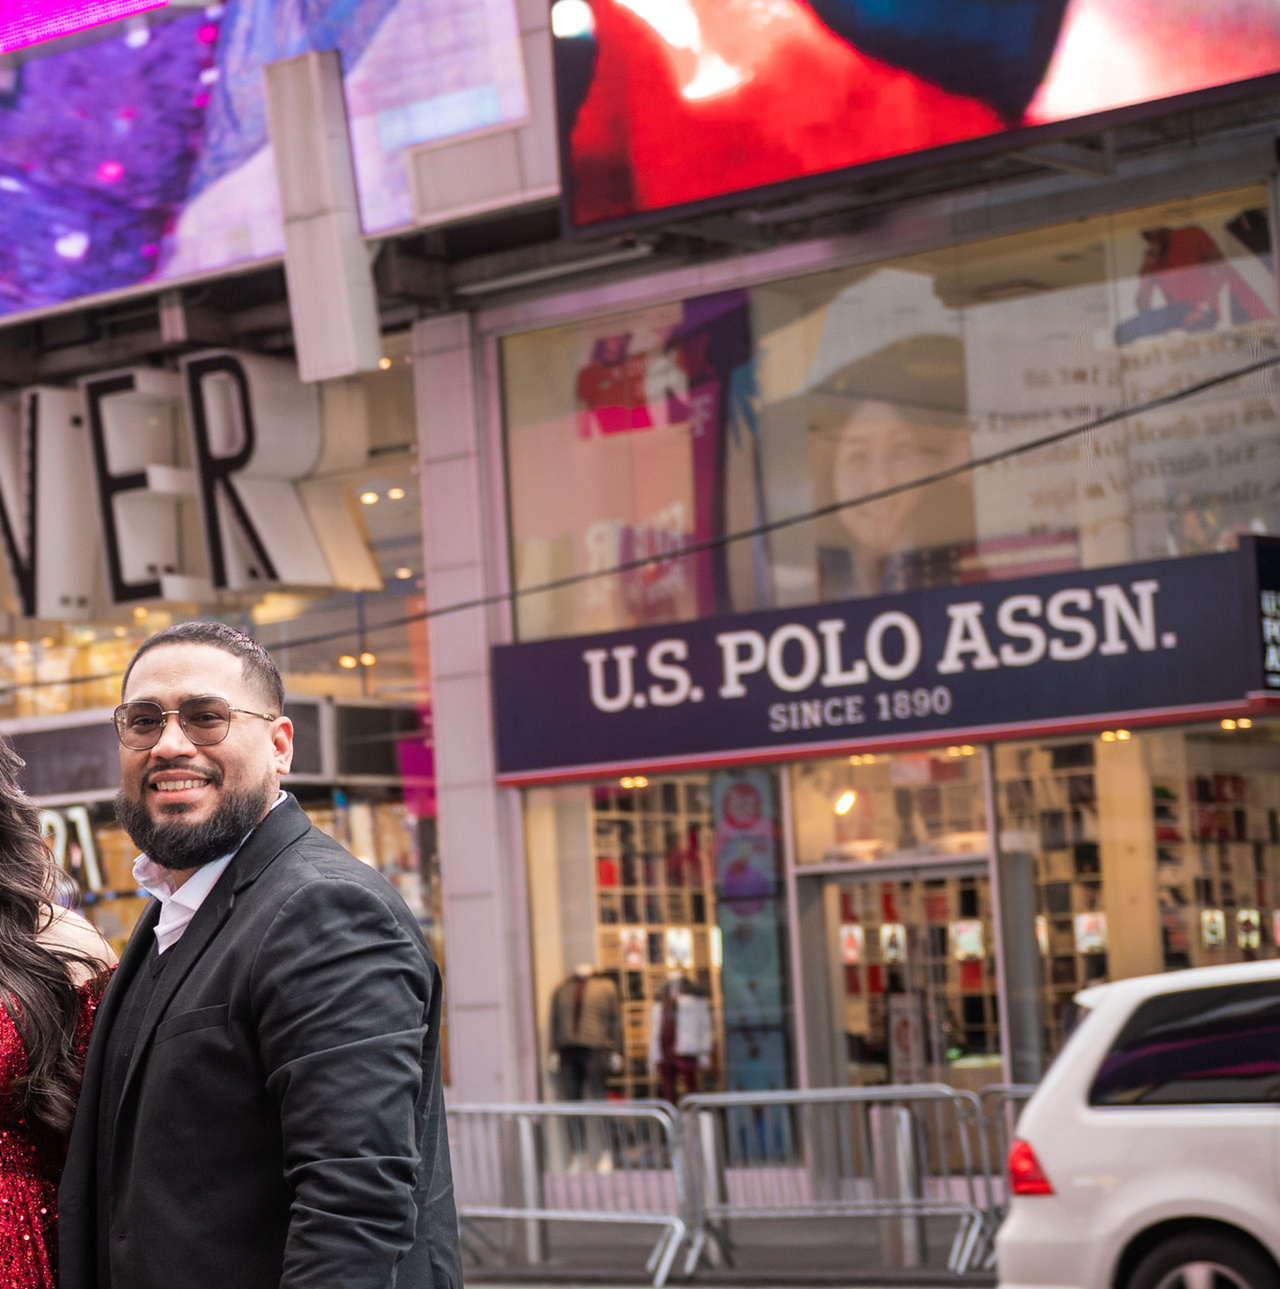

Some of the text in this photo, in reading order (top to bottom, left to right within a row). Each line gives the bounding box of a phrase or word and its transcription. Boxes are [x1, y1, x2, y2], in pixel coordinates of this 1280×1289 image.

[584, 580, 1176, 712] U.S. POLO ASSN.
[769, 687, 951, 732] SINCE 1890
